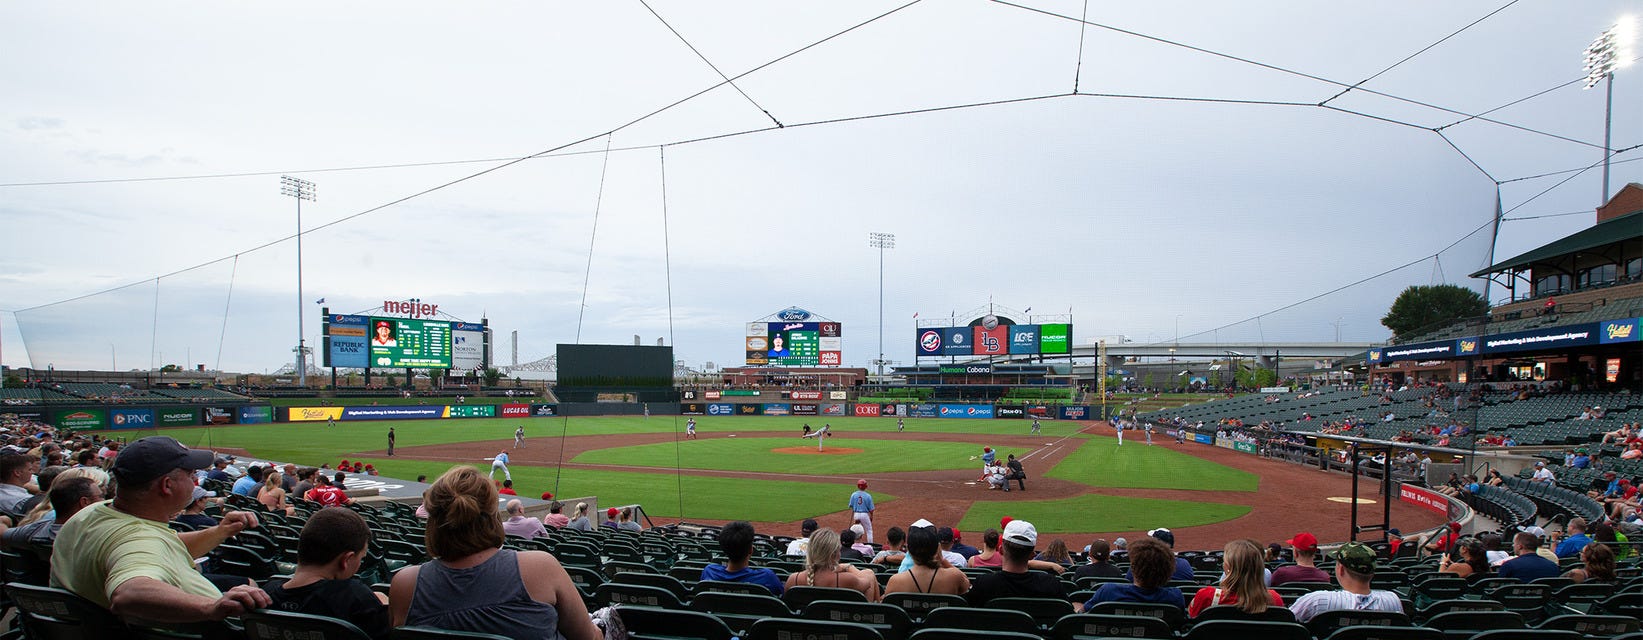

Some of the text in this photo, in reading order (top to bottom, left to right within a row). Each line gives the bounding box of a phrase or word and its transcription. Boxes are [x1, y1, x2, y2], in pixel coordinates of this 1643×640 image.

[384, 299, 438, 318] meijer
[783, 311, 804, 320] Ford
[855, 406, 878, 415] CORT
[127, 414, 151, 424] PNC
[858, 496, 863, 505] 3
